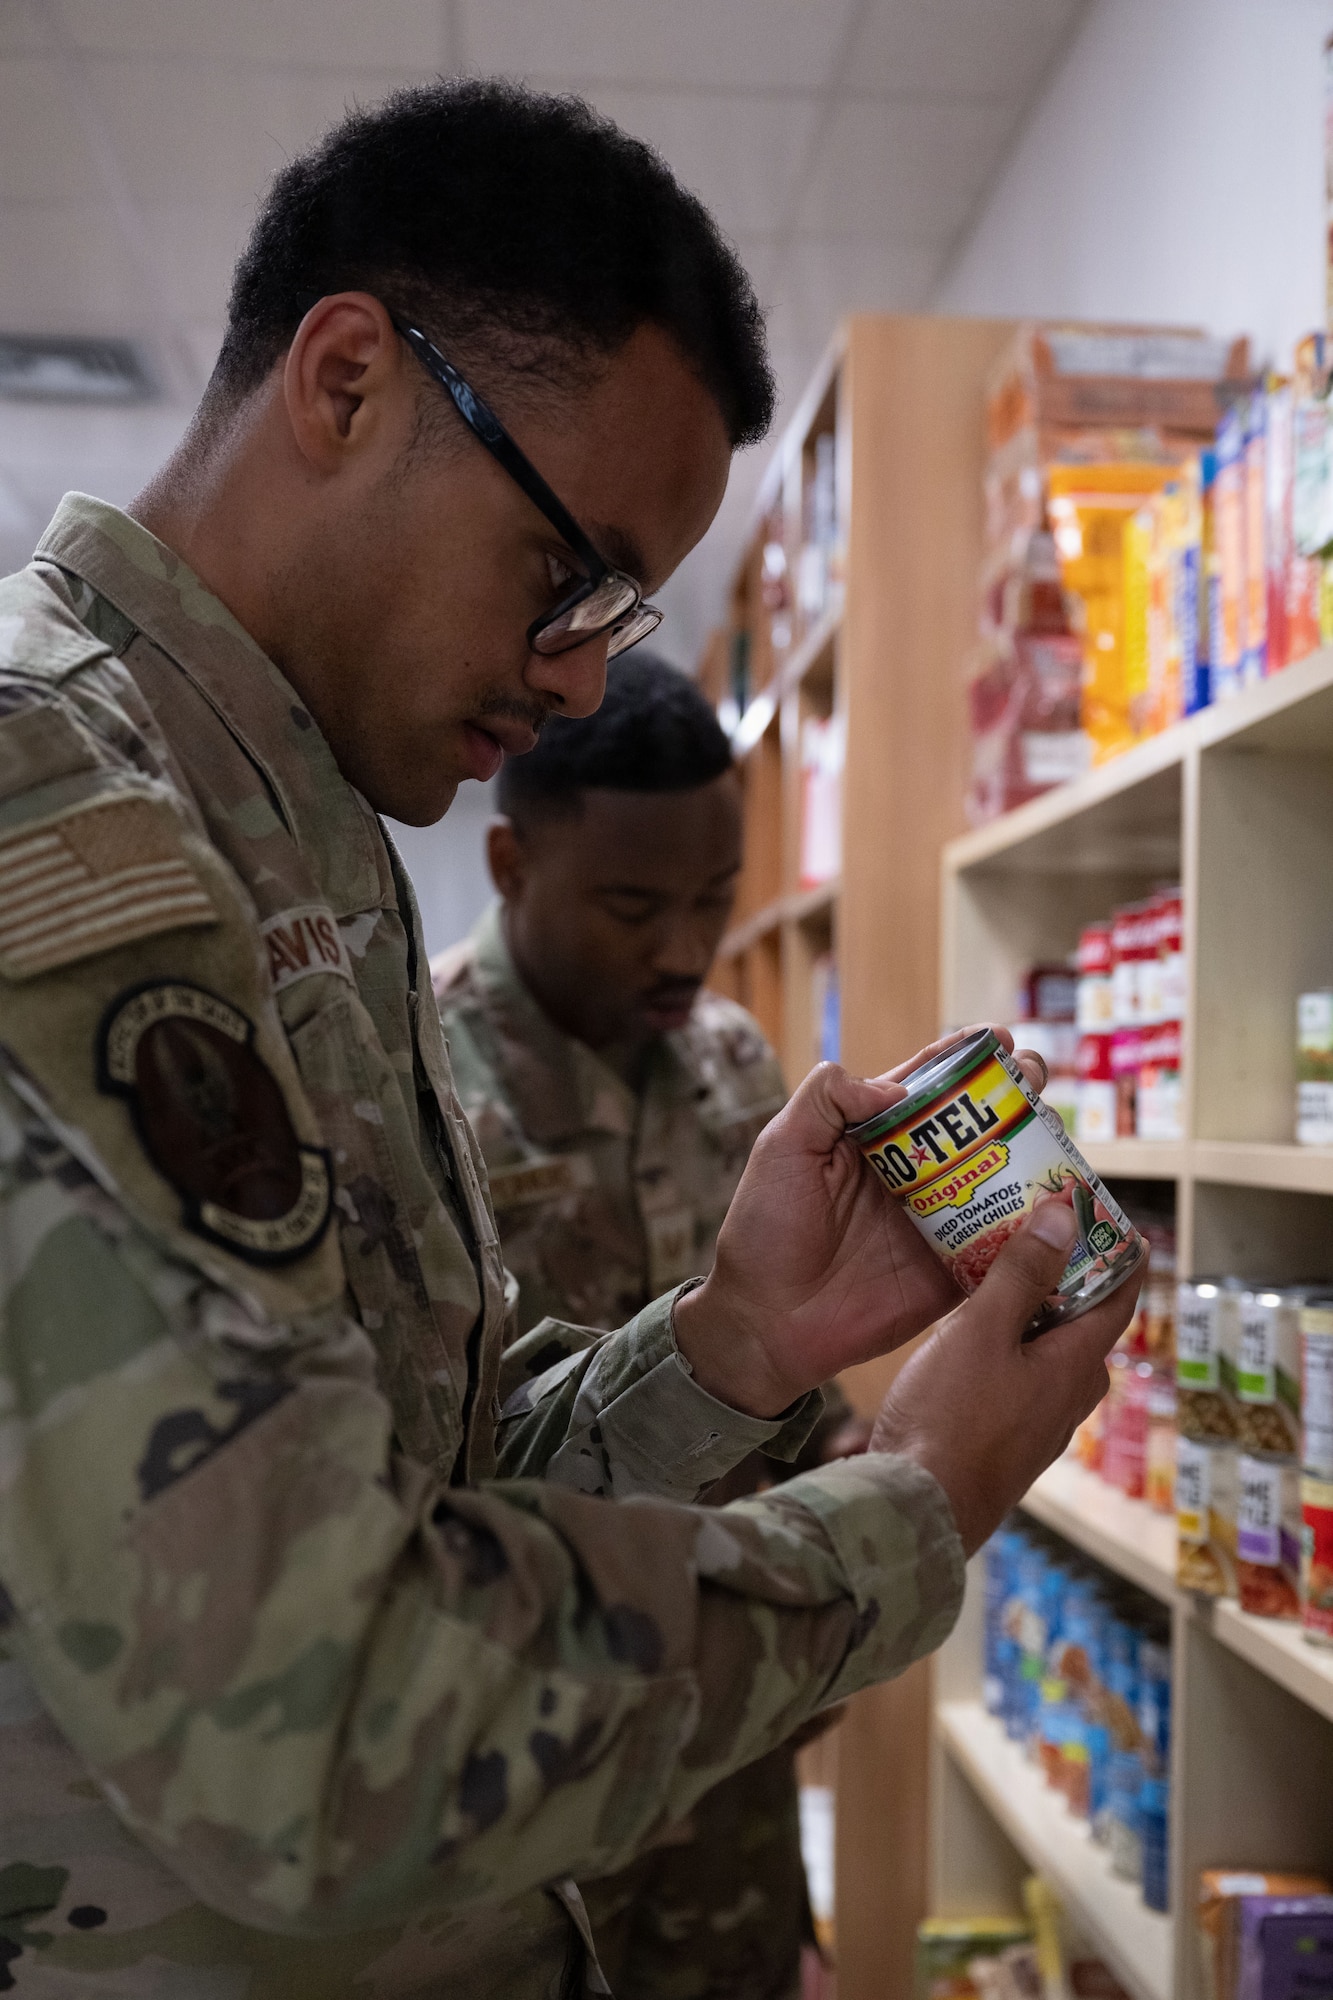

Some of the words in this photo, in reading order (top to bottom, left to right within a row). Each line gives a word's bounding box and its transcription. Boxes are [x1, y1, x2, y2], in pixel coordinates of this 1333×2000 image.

[913, 1149, 1002, 1211] Original
[935, 1217, 957, 1242] DICED
[955, 1181, 1022, 1224] TOMATOES
[946, 1238, 956, 1251] &
[953, 1218, 984, 1245] GREEN
[983, 1196, 1025, 1227] CHILIES
[1091, 1227, 1105, 1241] NON
[1094, 1232, 1110, 1247] BPA
